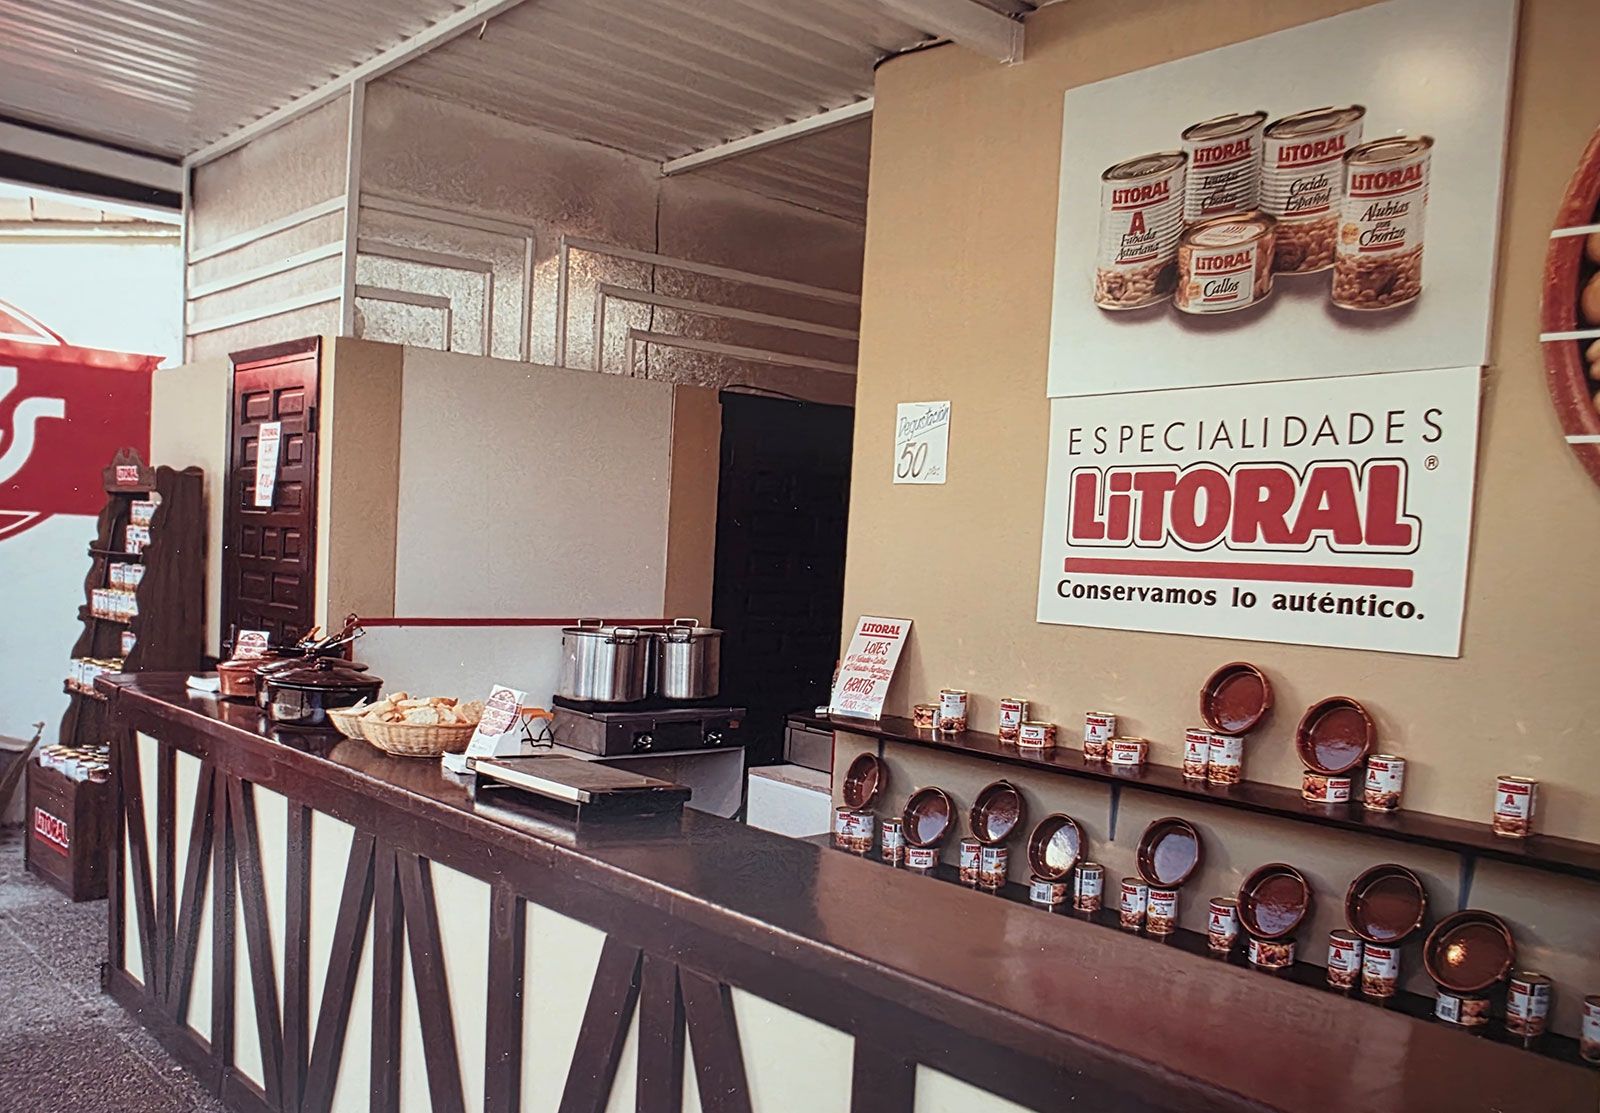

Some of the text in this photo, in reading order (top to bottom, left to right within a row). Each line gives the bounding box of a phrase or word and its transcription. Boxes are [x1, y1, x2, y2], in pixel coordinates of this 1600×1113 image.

[1290, 174, 1328, 195] Cocido
[1360, 201, 1411, 221] Alubias
[1129, 211, 1145, 236] A
[1359, 227, 1406, 246] Chorizo
[1203, 278, 1240, 297] Callos
[1068, 408, 1442, 455] ESPECIALIDADES
[897, 442, 928, 478] 50
[1057, 580, 1425, 620] Conservamos lo auténtico.
[863, 641, 891, 655] LOTES
[843, 676, 875, 694] GRATIS
[1504, 794, 1514, 805] A
[1333, 949, 1342, 959] A
